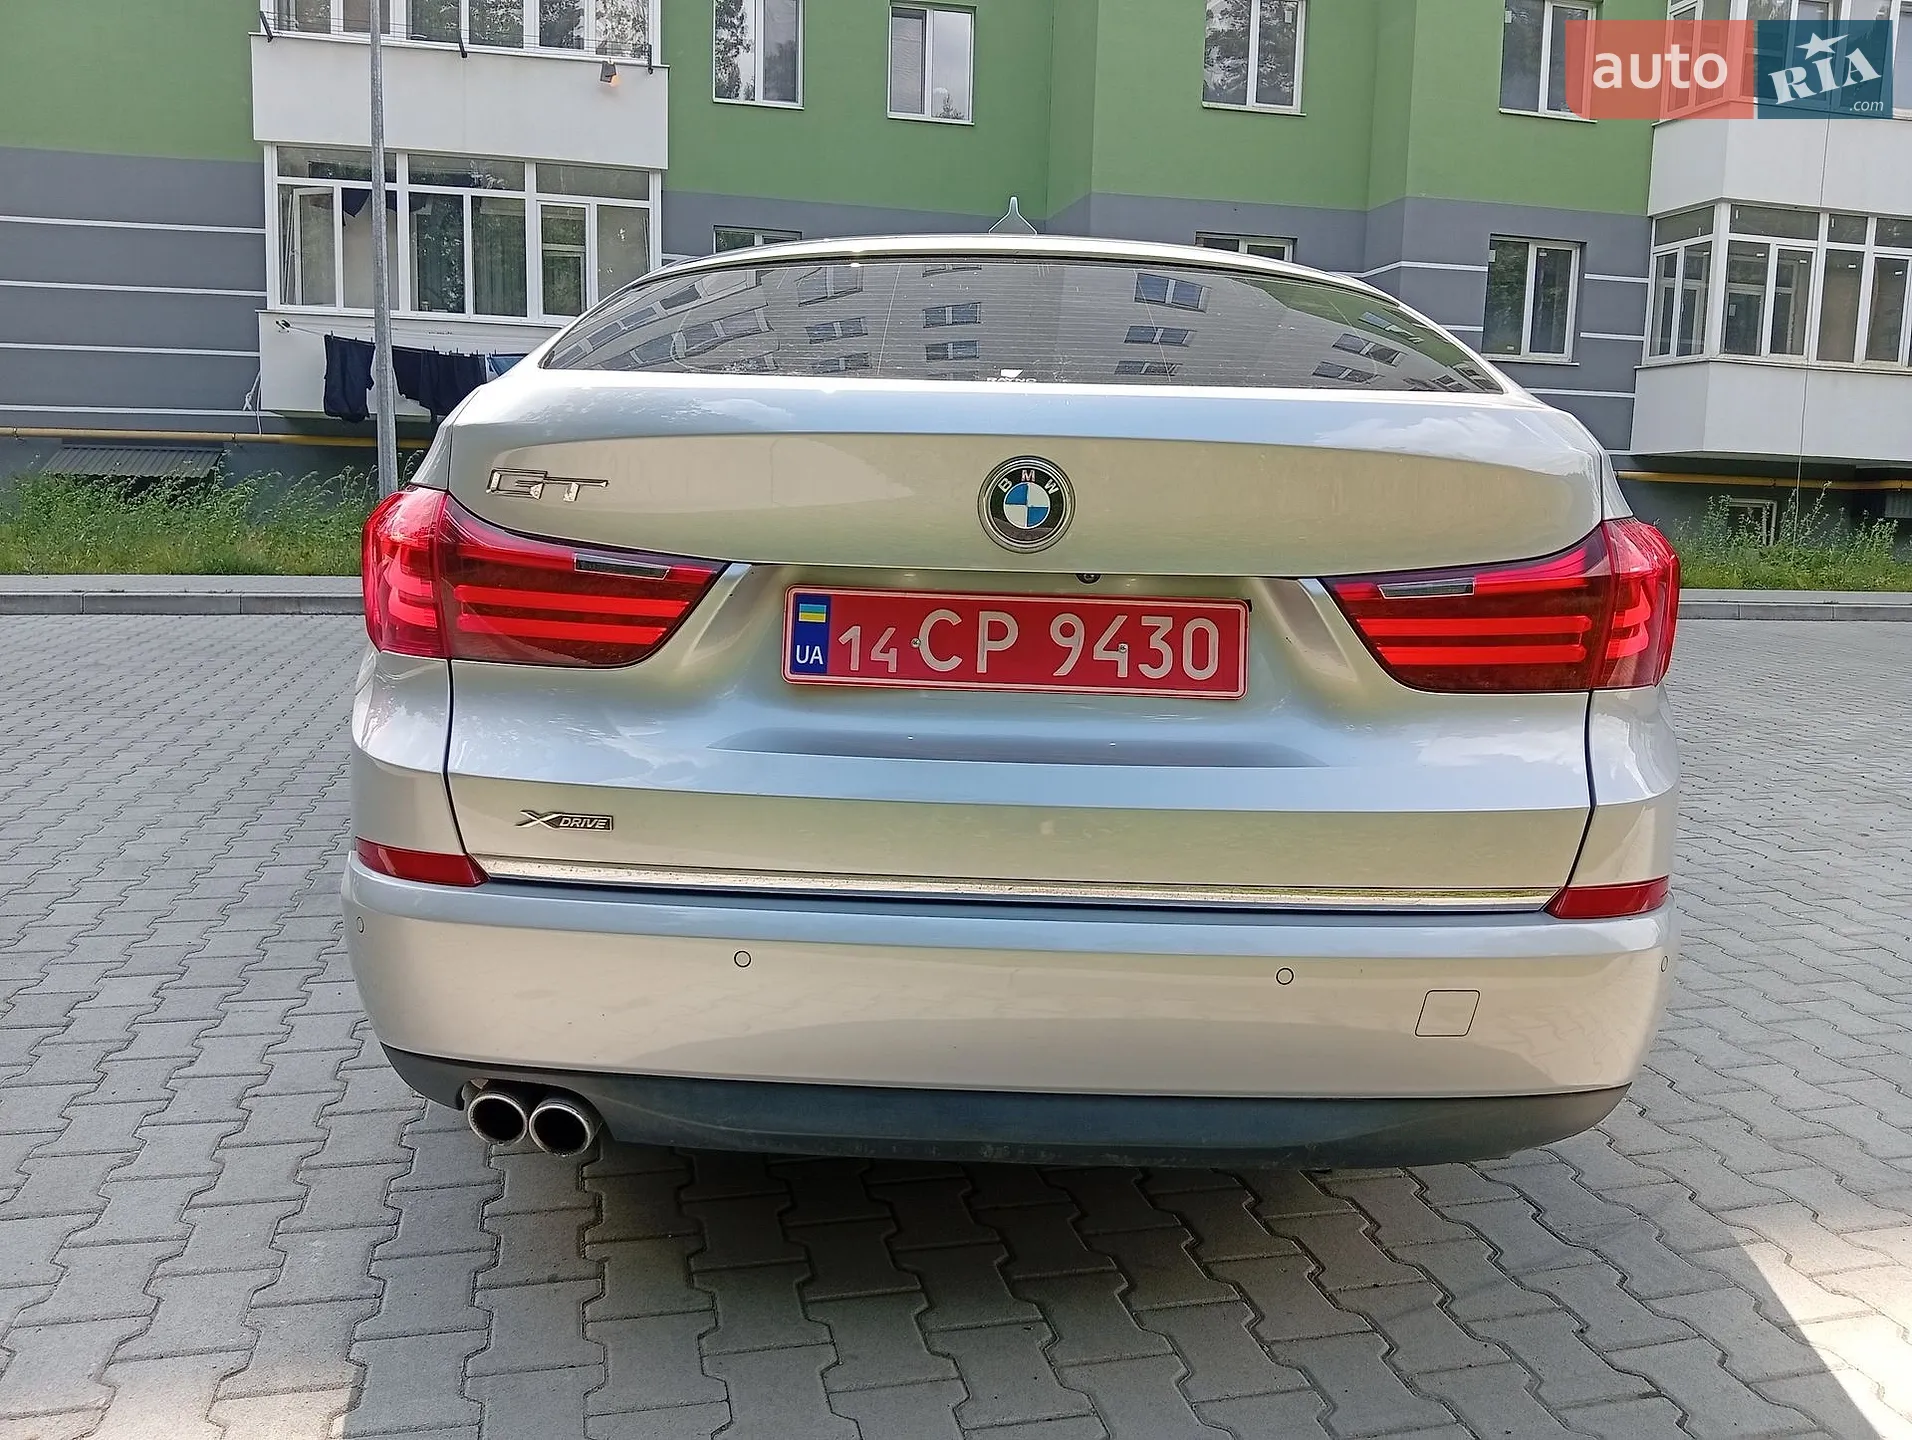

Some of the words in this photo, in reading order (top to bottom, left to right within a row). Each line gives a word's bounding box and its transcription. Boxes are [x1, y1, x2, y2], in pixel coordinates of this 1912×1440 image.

[486, 467, 608, 502] GT
[998, 469, 1059, 495] BMW
[796, 644, 824, 665] UA
[838, 625, 898, 673] 14
[1050, 612, 1220, 681] 9430
